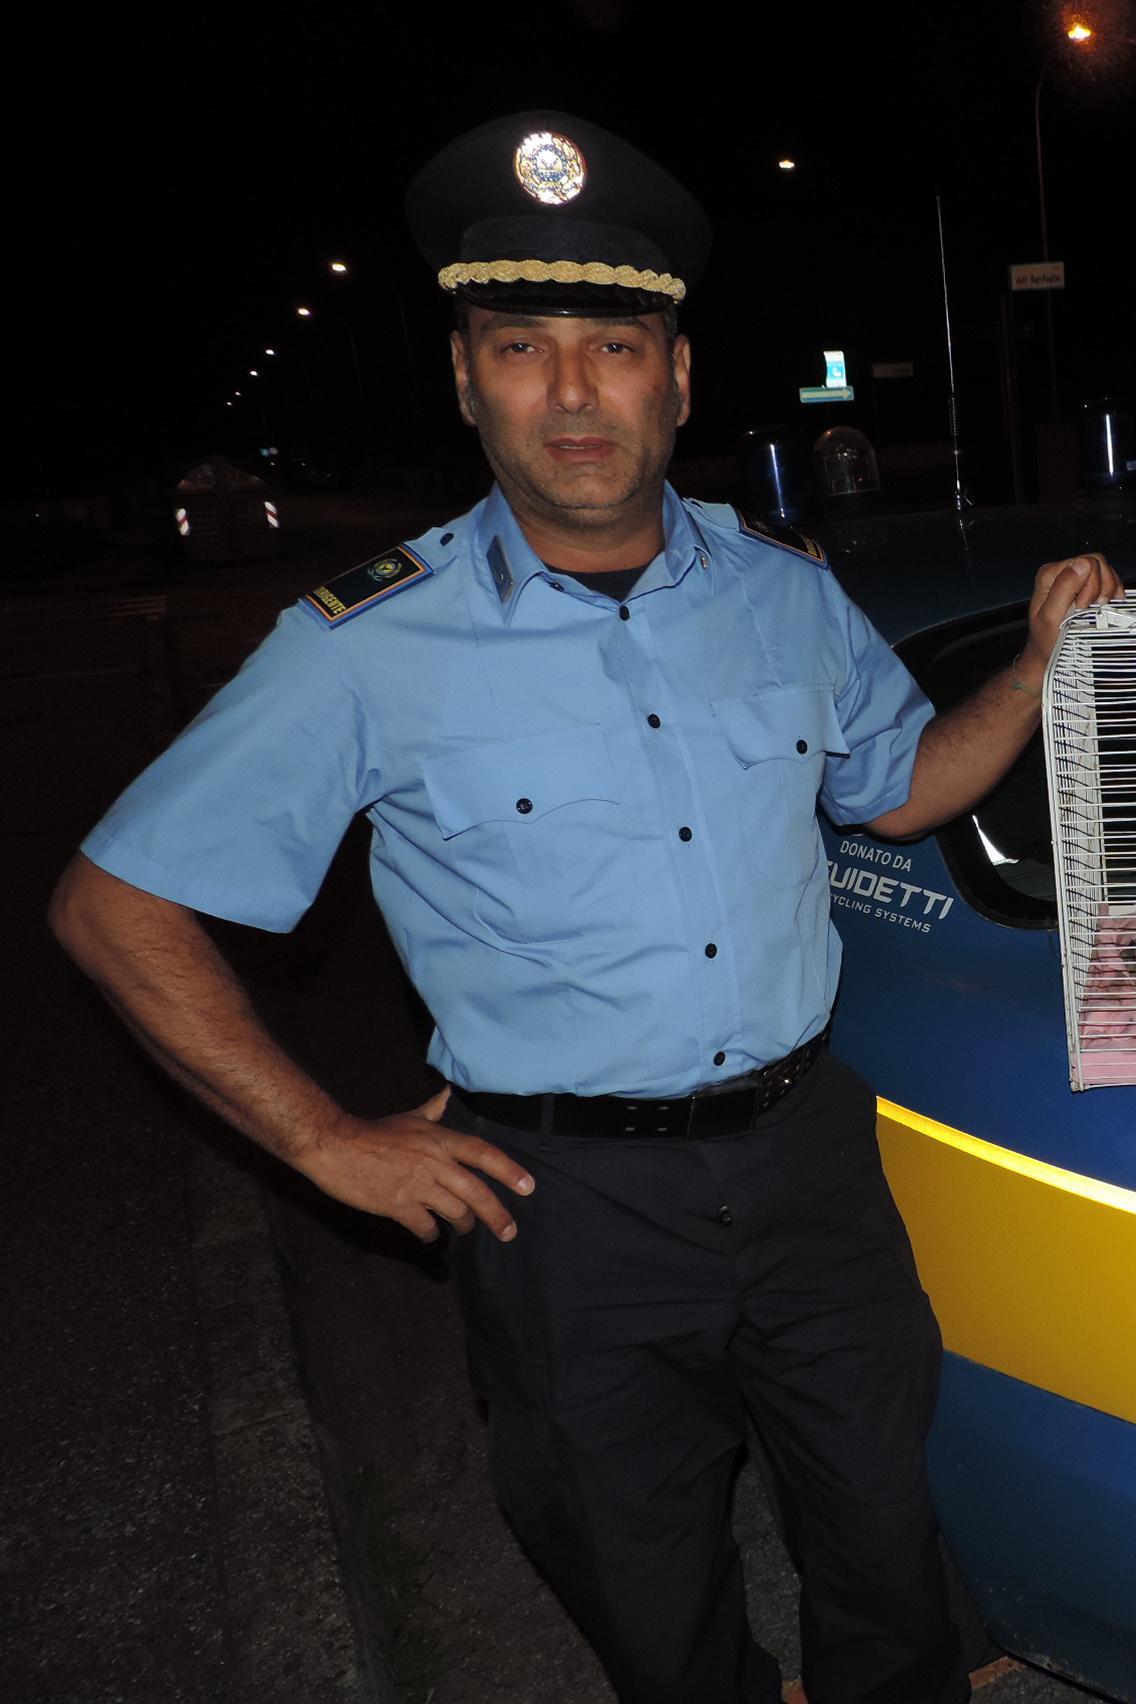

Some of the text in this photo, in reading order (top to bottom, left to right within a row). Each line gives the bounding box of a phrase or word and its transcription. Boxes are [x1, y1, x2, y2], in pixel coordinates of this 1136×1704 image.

[840, 841, 912, 872] DONATO DA
[827, 860, 954, 919] UIDETTI
[831, 893, 932, 933] YCLING SYSTEMS
